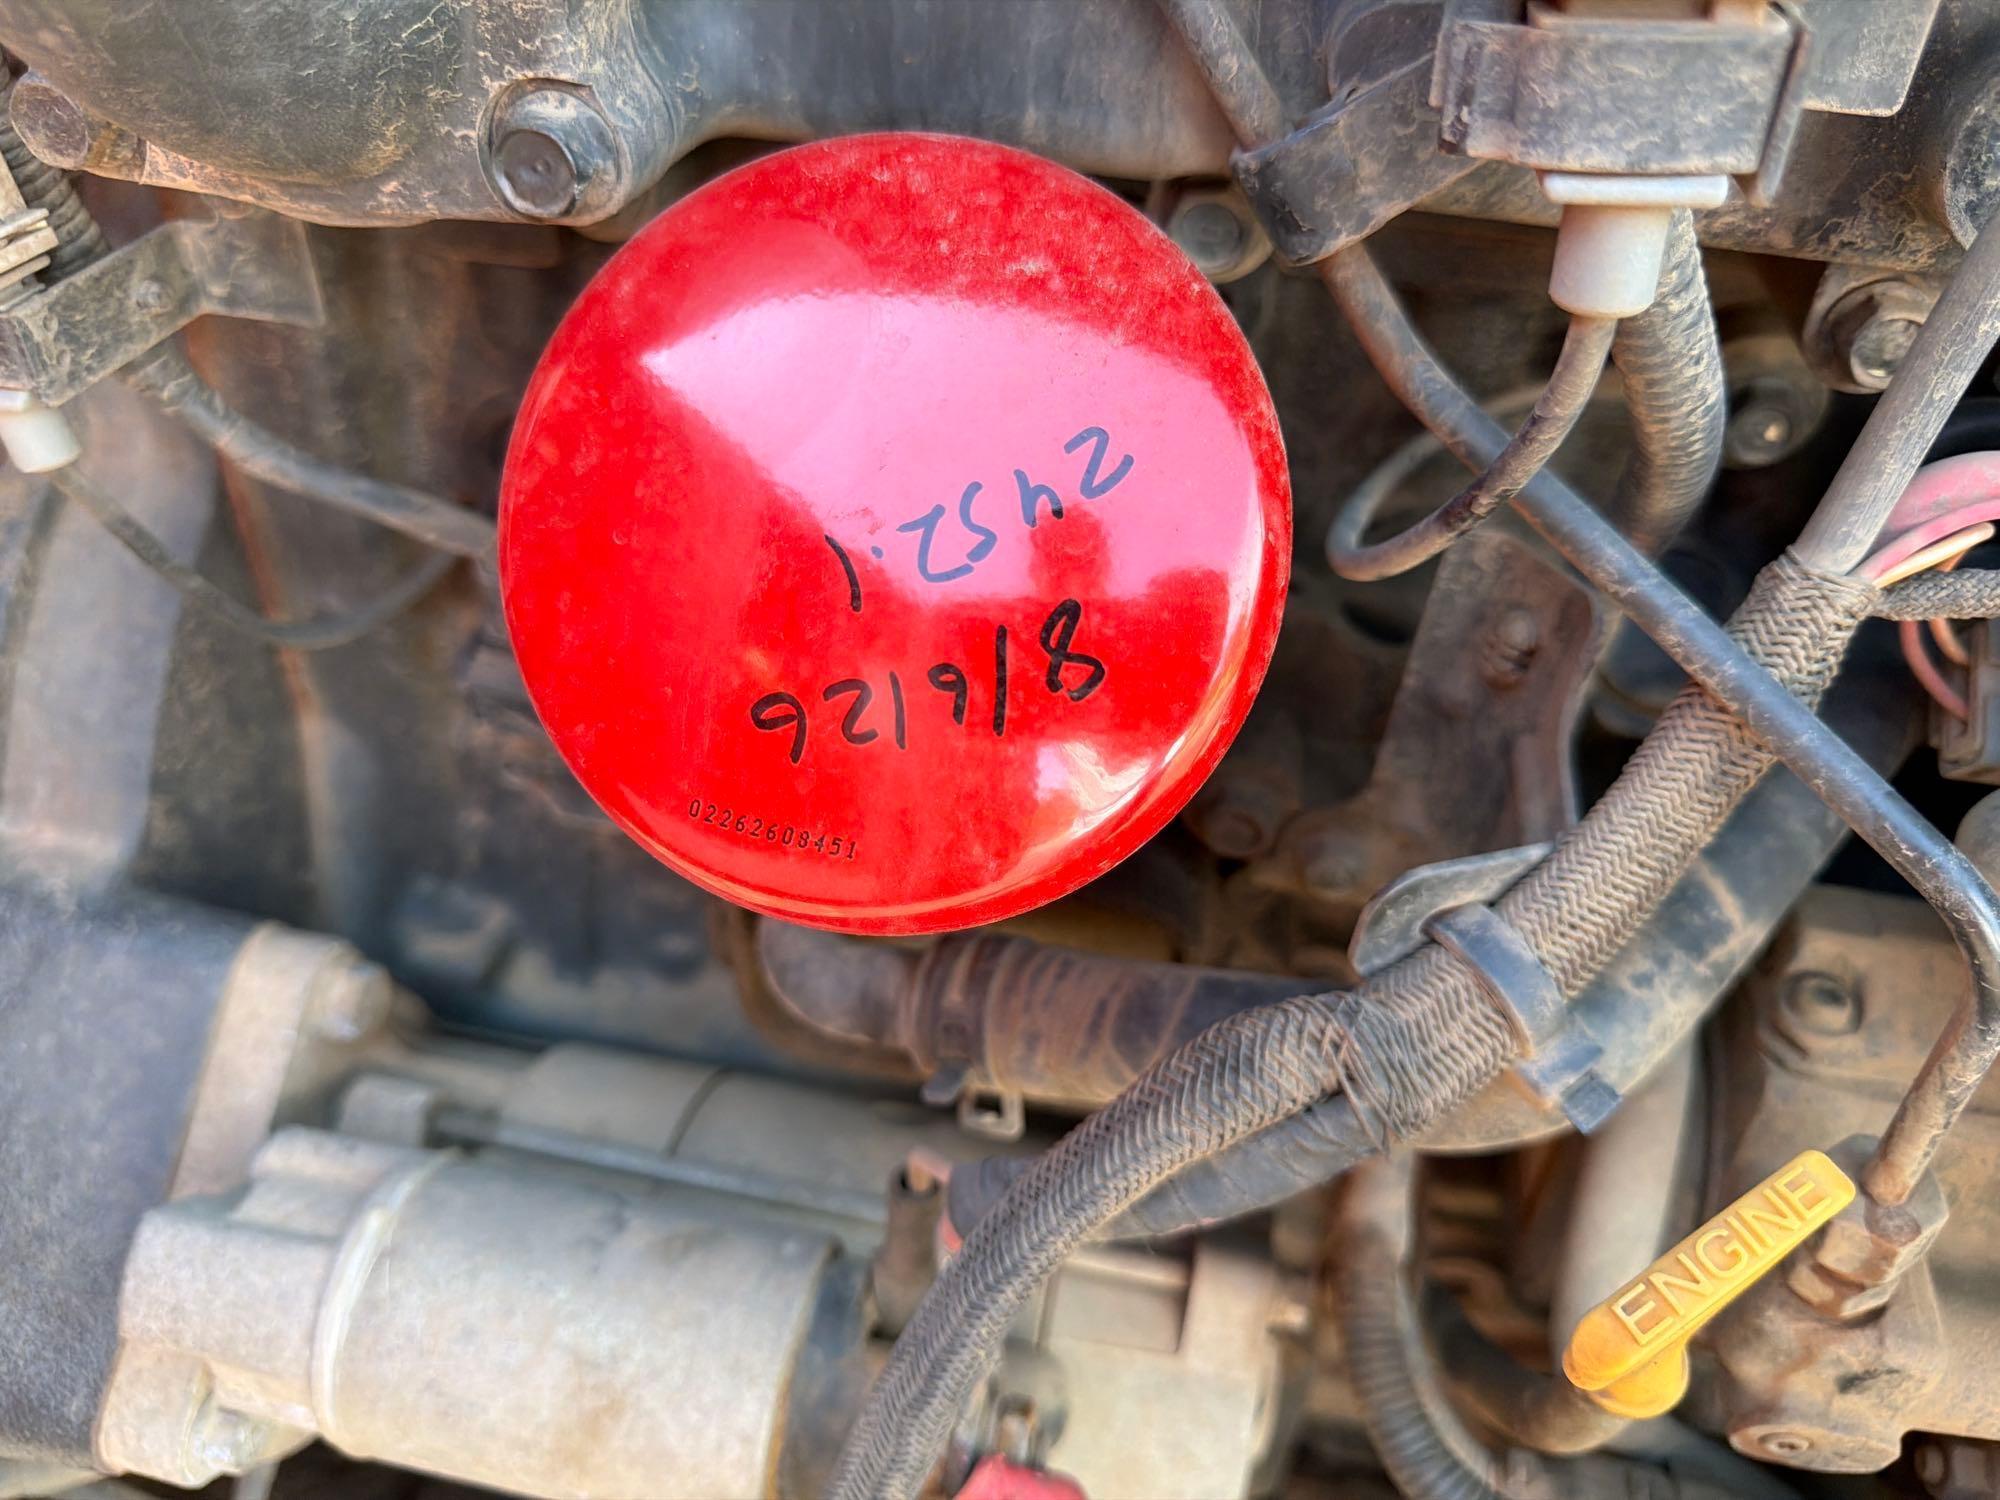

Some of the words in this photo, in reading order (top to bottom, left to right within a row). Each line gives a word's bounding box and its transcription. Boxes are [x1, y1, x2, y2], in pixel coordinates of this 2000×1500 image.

[825, 426, 1135, 611] 2452.1
[688, 799, 857, 860] 02262608451
[1611, 1165, 1832, 1346] ENGINE
